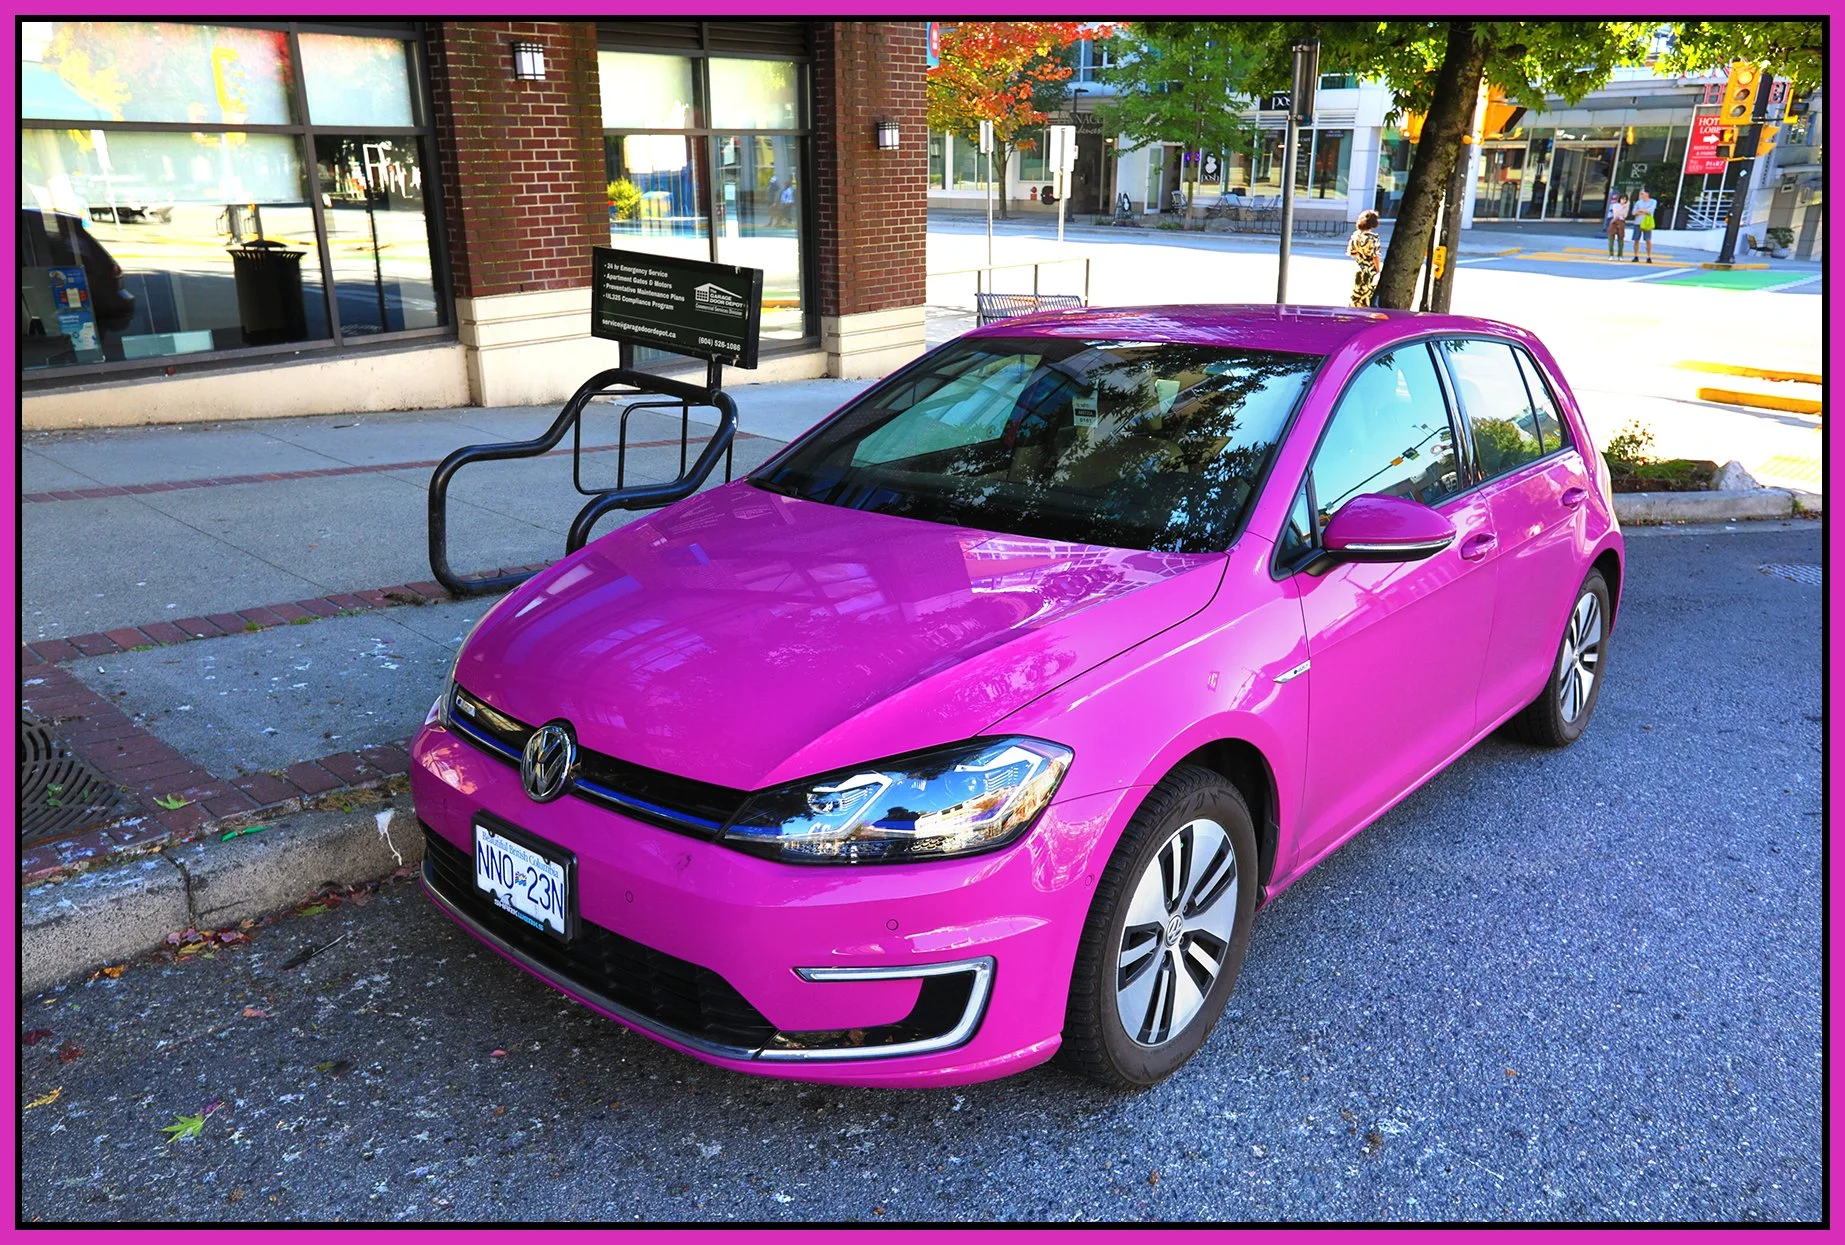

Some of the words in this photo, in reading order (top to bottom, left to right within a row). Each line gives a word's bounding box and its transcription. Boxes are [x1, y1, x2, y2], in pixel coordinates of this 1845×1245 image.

[620, 265, 648, 276] Emergency
[648, 269, 668, 278] Service
[606, 273, 632, 282] Apartment
[633, 277, 648, 285] Gates
[654, 280, 672, 289] Motors
[606, 283, 636, 294] Preventative
[637, 288, 670, 299] Maintenance
[670, 294, 685, 302] Plans
[622, 296, 651, 306] Compliance
[652, 300, 674, 310] Program
[695, 302, 714, 310] Commercial
[602, 318, 676, 338] service@garagedoordepot.ca
[698, 336, 713, 347] (604)
[482, 830, 509, 852] Beautiful
[508, 844, 528, 862] British
[529, 854, 559, 878] Columbia
[526, 866, 564, 920] 23N
